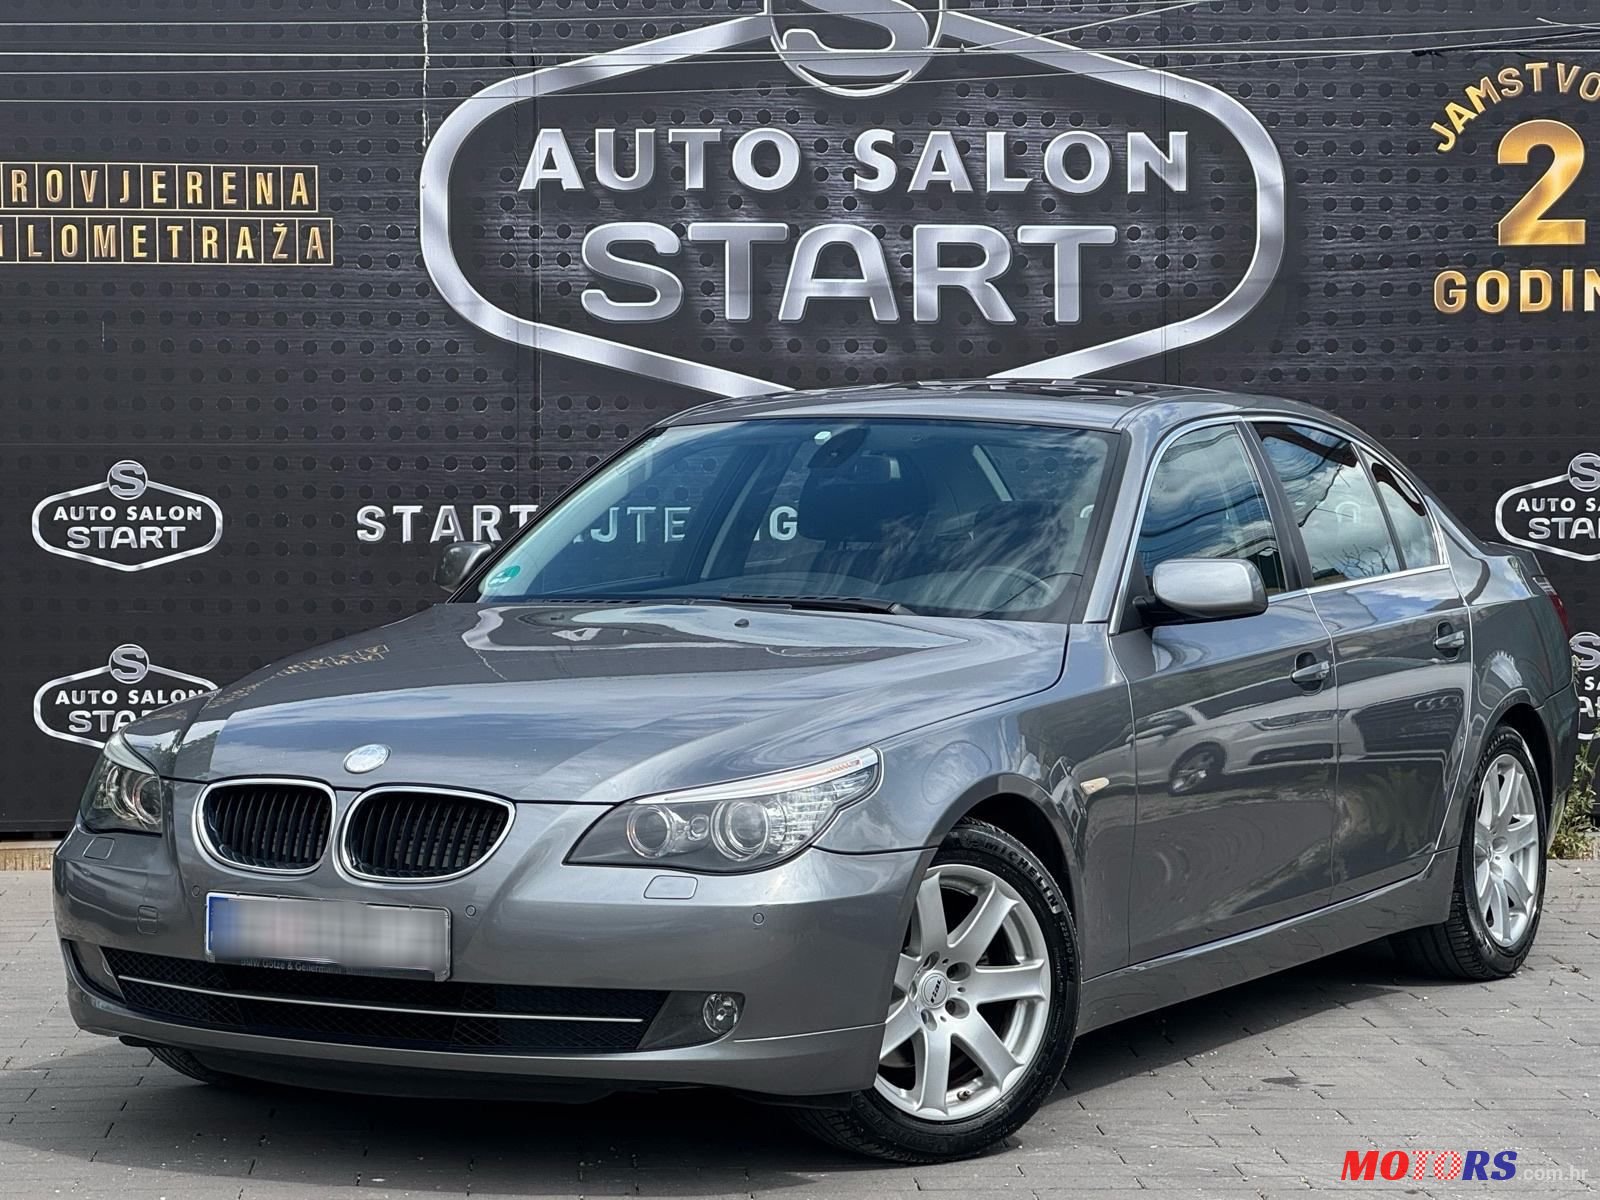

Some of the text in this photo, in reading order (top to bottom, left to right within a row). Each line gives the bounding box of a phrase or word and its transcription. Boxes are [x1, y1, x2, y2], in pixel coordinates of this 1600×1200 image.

[1430, 62, 1600, 152] JAMSTVO
[518, 127, 1190, 194] AUTO SALON
[11, 169, 310, 206] ROVJERENA
[1497, 119, 1586, 246] 2
[580, 222, 1118, 325] START
[110, 464, 145, 496] S
[53, 505, 202, 521] AUTO SALON
[1515, 497, 1576, 513] AUTO
[66, 526, 186, 549] START
[1528, 516, 1600, 540] STA
[112, 647, 146, 680] S
[55, 689, 118, 705] AUTO
[68, 710, 154, 733] STA
